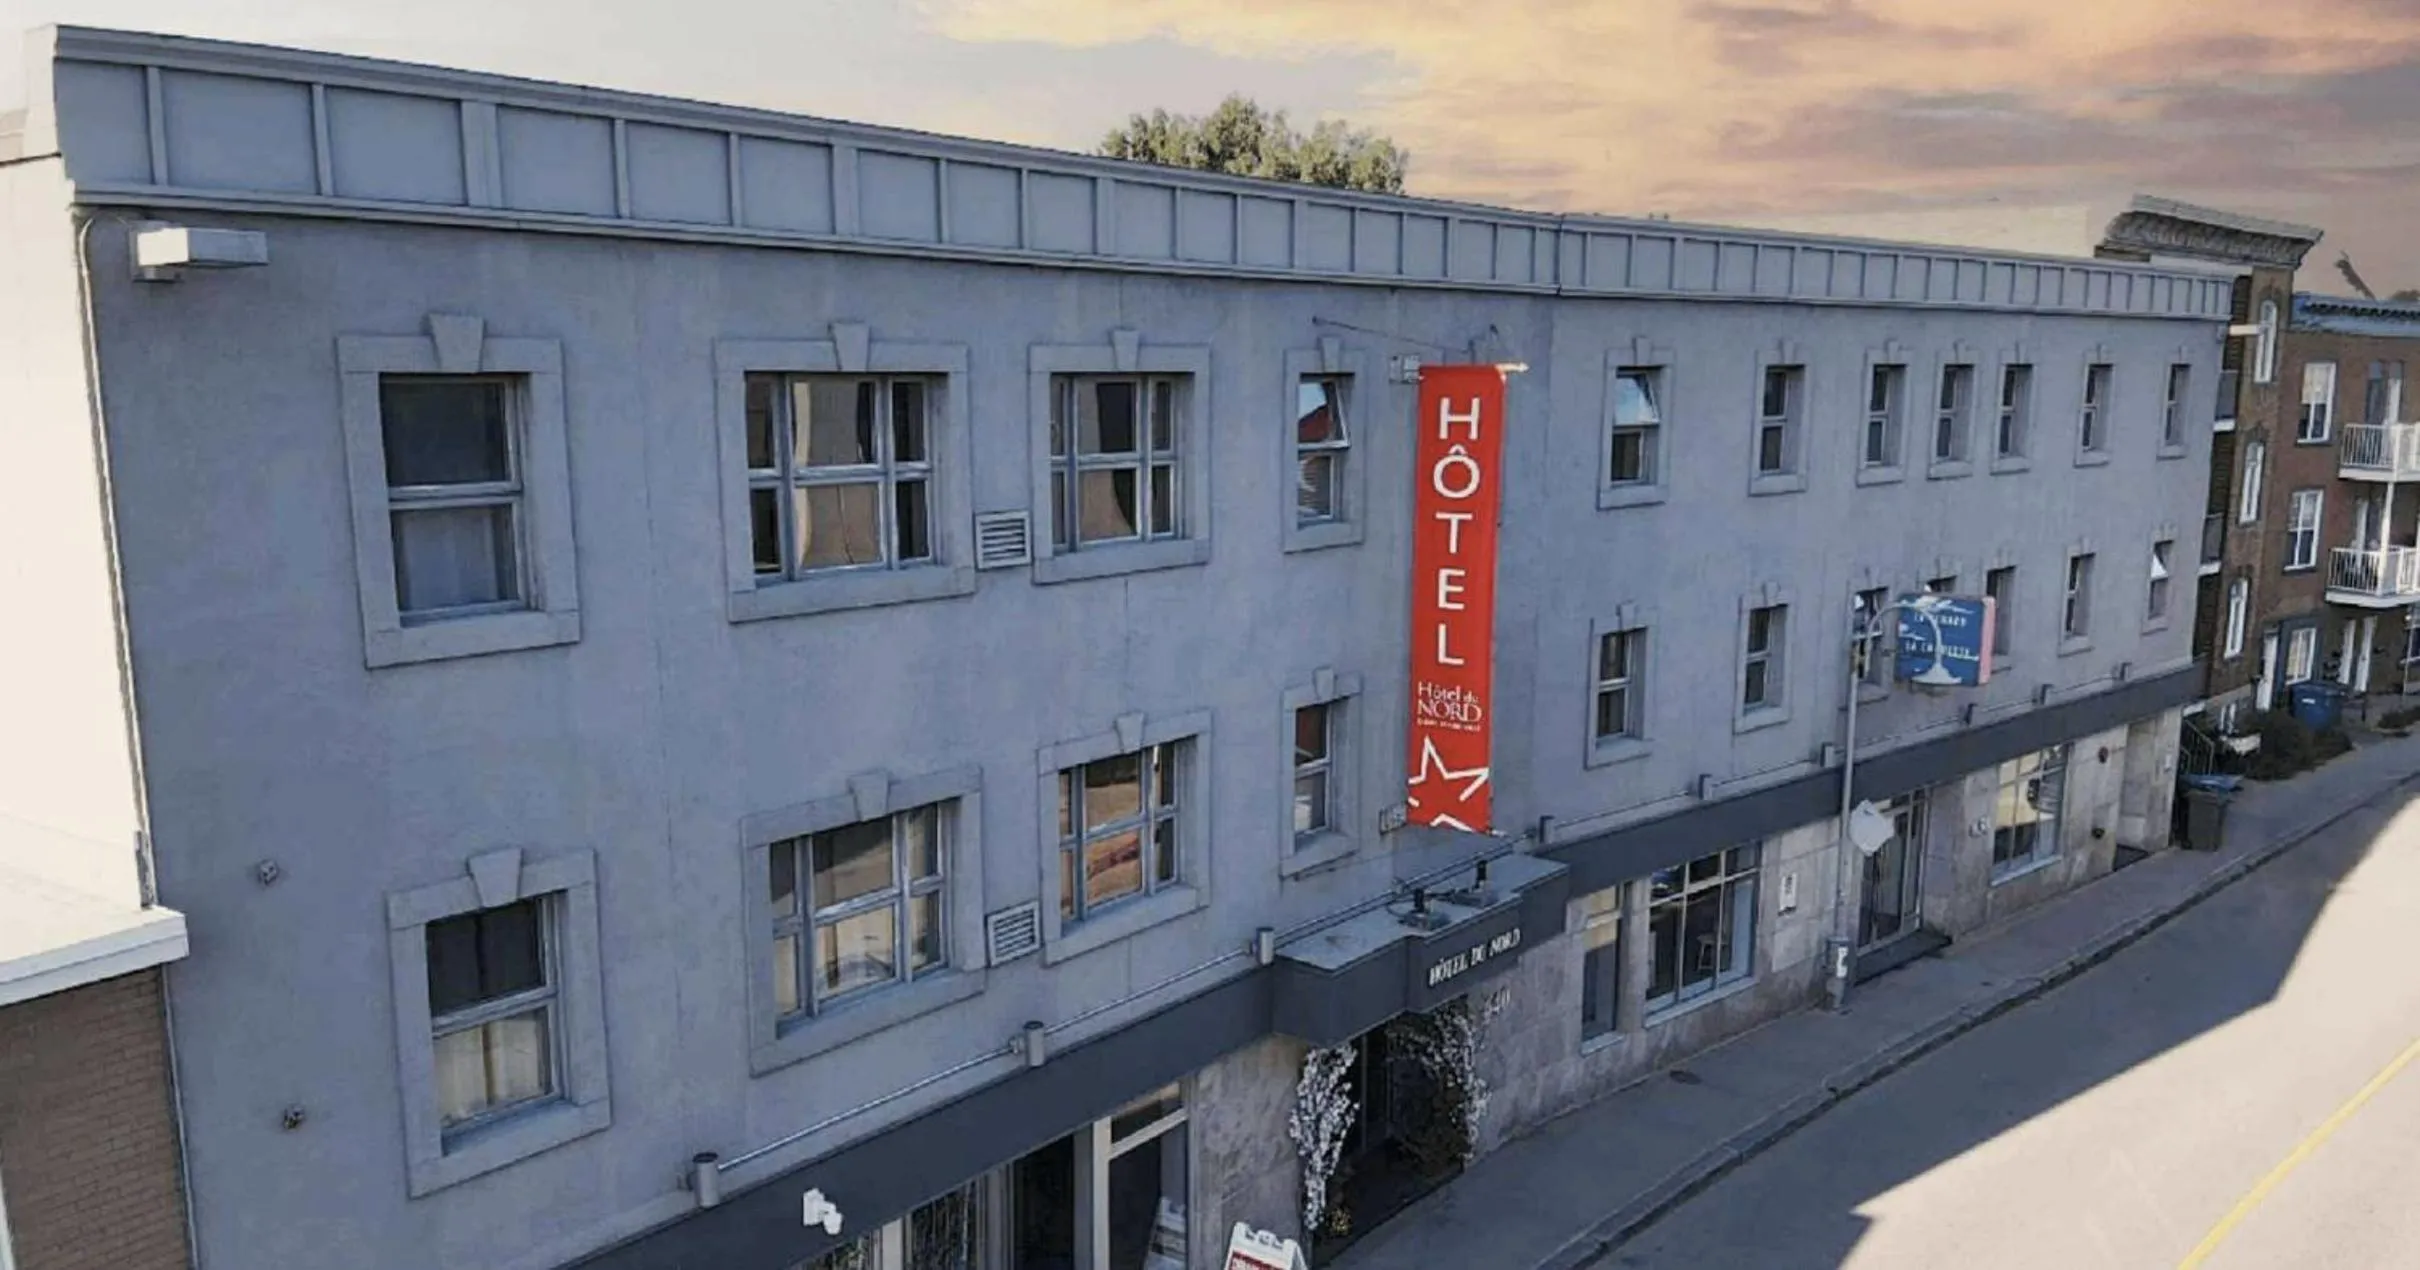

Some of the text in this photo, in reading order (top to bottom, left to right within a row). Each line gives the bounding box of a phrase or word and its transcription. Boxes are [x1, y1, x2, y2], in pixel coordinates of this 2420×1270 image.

[1432, 397, 1481, 665] HÔTEL
[1418, 681, 1479, 702] Hôtel du
[1418, 699, 1482, 721] NORD
[1429, 928, 1521, 988] HÔTEL DU NORD
